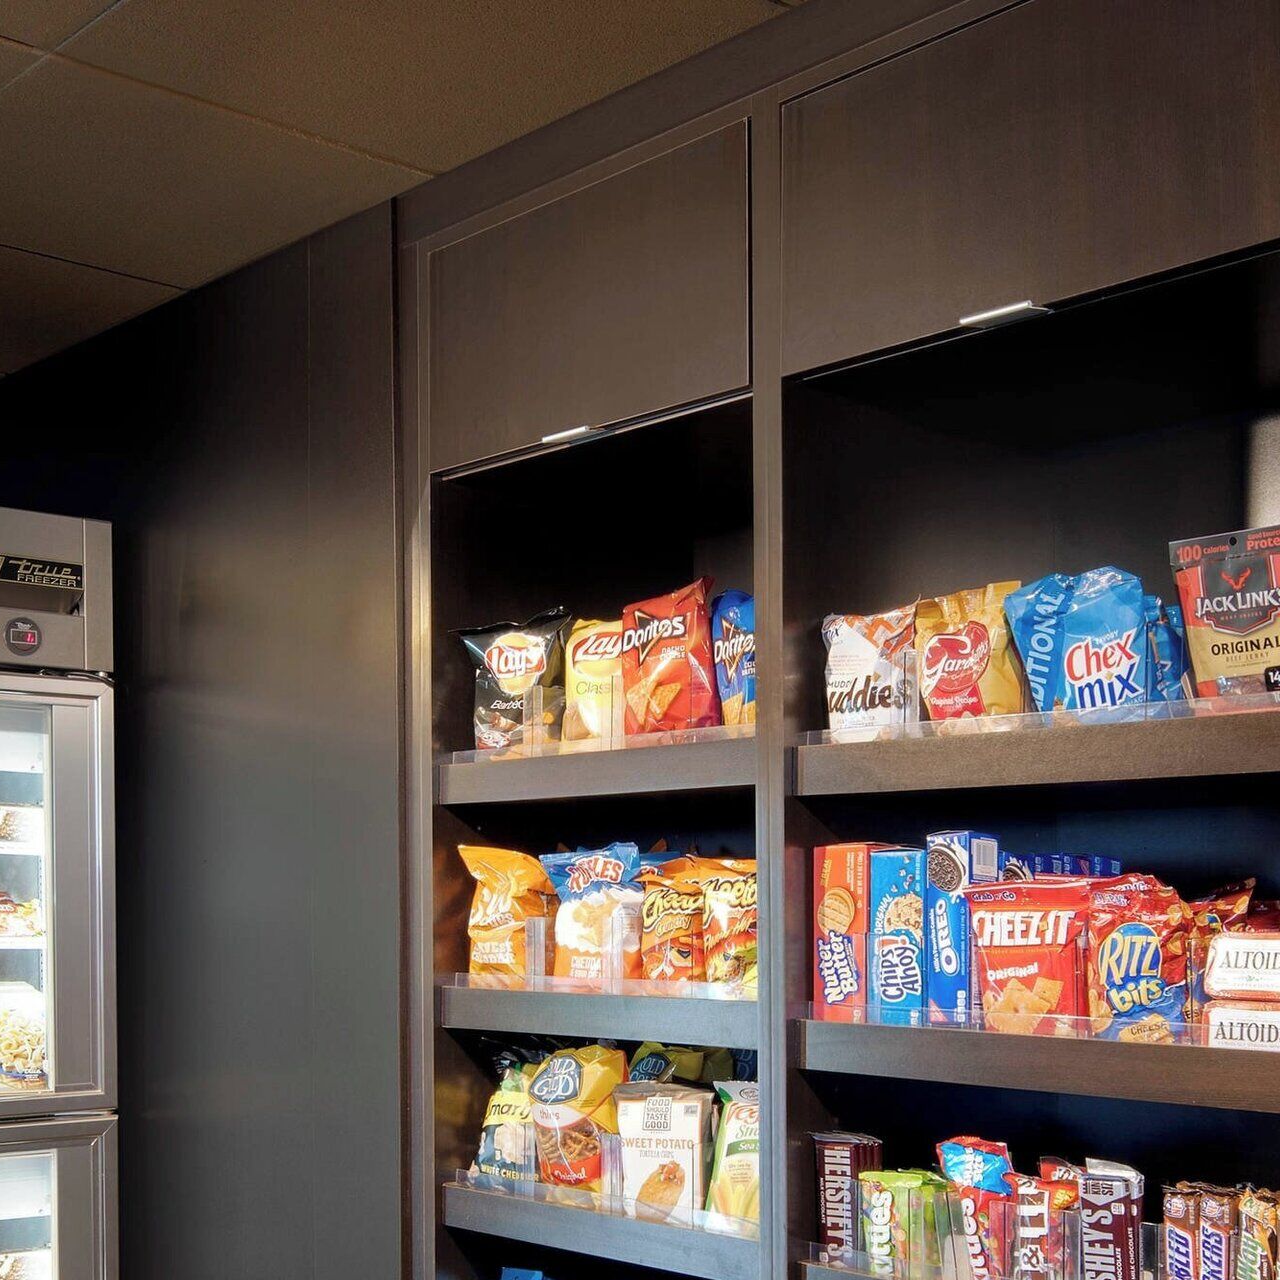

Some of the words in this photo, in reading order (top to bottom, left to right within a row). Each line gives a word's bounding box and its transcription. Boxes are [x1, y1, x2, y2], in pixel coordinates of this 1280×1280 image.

[1177, 545, 1202, 563] 100
[1203, 545, 1230, 554] Calories
[17, 574, 77, 588] FREEZER
[1195, 597, 1237, 618] JACK
[622, 615, 686, 653] Doritos
[714, 634, 755, 664] Dorito
[1066, 633, 1137, 681] Chex
[567, 856, 624, 892] RUFFLES
[1002, 891, 1016, 902] Go
[934, 899, 961, 976] OREO
[818, 939, 845, 1005] Nutter
[829, 930, 859, 998] Butter
[880, 946, 905, 1002] Chips
[901, 944, 921, 995] Ahoy
[1099, 931, 1161, 986] RITZ
[1108, 977, 1163, 1013] bits
[646, 1098, 671, 1107] FOOD
[646, 1113, 668, 1121] TASTE
[644, 1120, 669, 1129] GOOD
[619, 1138, 653, 1149] SWEET
[655, 1138, 694, 1150] POTATO
[824, 1149, 852, 1257] HERSHEY'S
